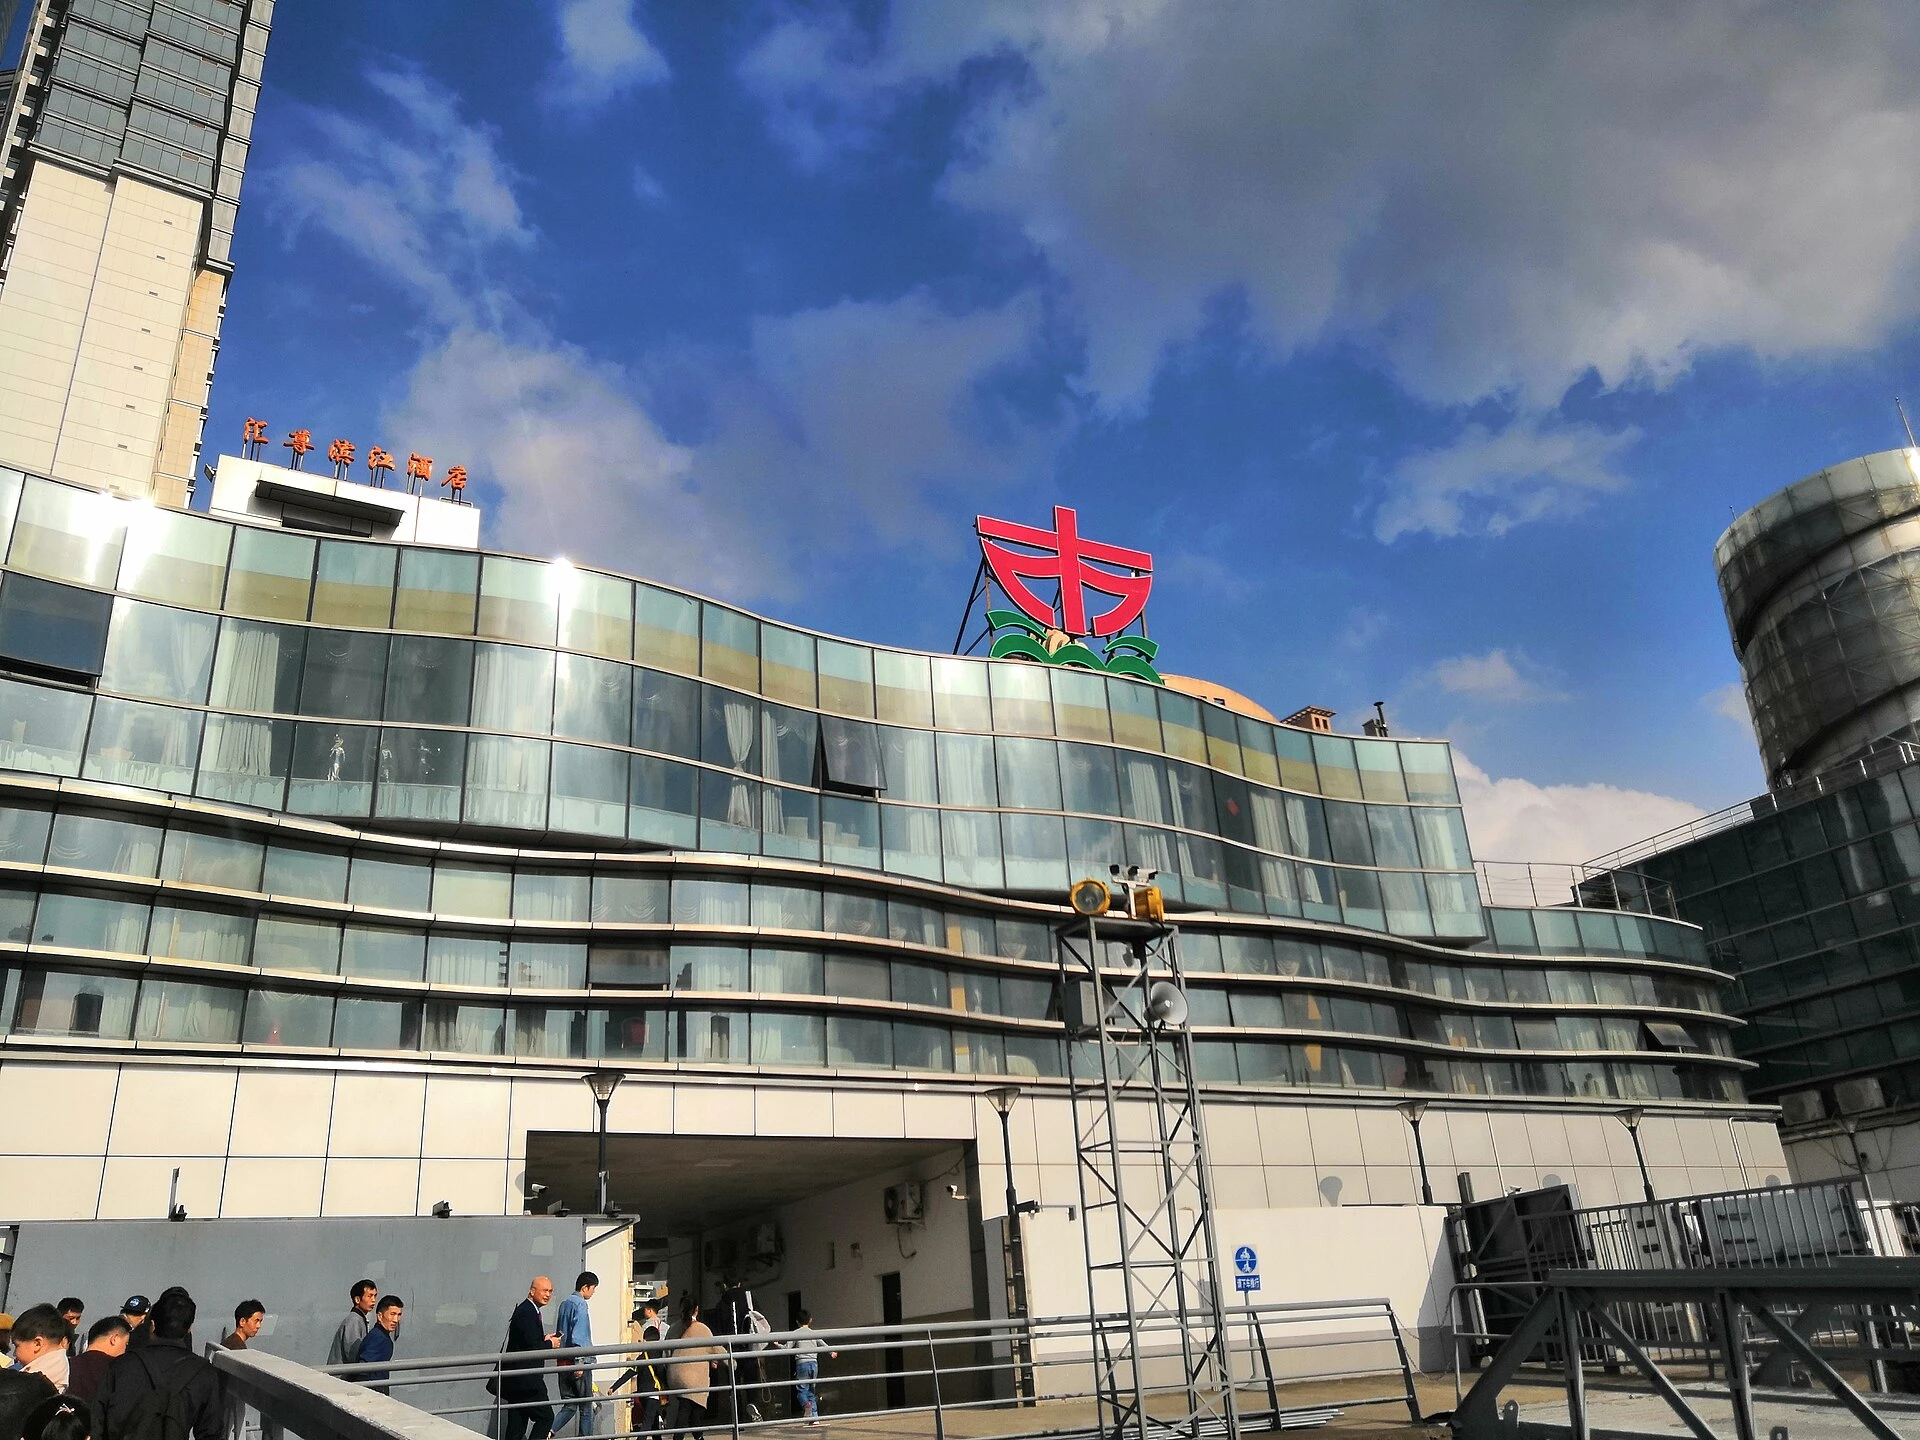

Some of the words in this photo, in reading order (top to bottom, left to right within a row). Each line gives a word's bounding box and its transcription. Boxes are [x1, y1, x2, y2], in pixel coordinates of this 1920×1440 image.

[243, 417, 467, 490] 汇尊滨江酒店
